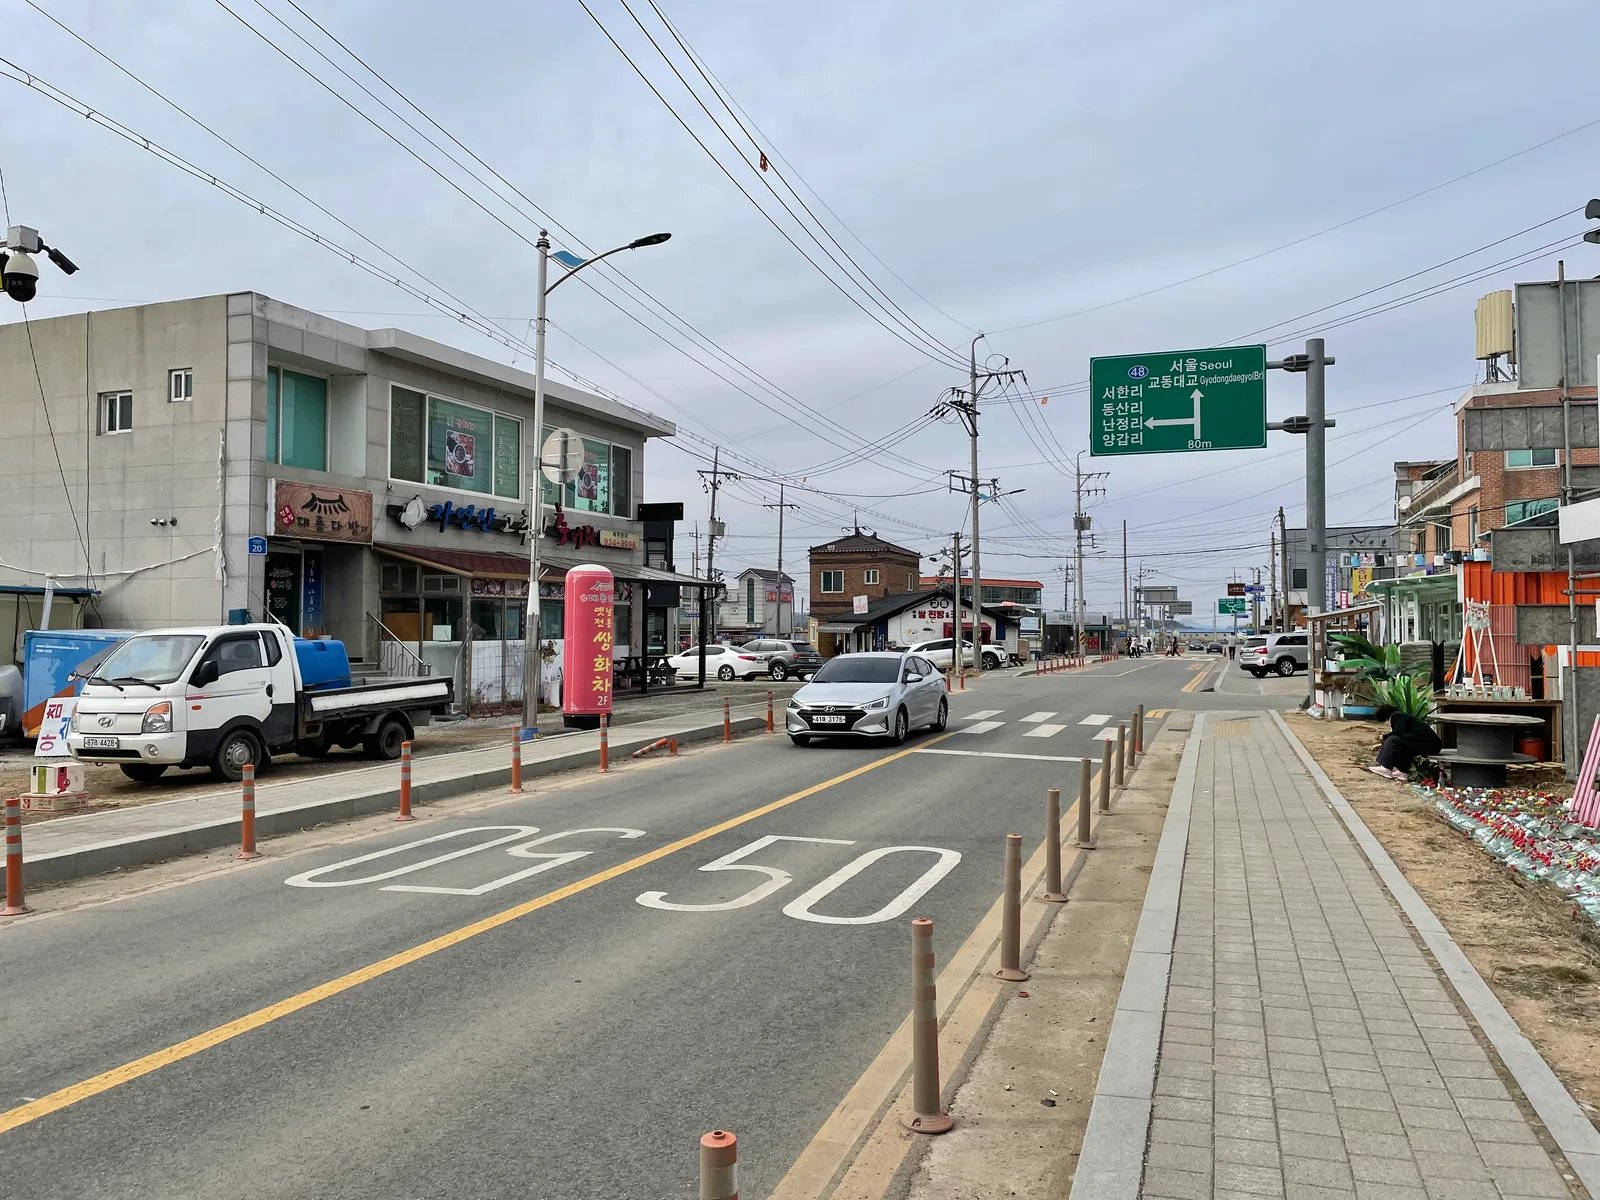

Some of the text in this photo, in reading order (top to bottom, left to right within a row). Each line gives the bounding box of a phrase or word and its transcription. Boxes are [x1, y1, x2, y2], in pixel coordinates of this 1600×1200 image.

[1130, 366, 1146, 377] 48
[1169, 358, 1233, 373] 서울 Seoul
[1148, 371, 1263, 389] 교동대교 Gyodongdaegyo(Br)
[1102, 384, 1144, 400] 서한리
[1102, 401, 1144, 416] 동산리
[1102, 417, 1144, 432] 난정리
[1102, 432, 1144, 447] 양갑리
[1187, 439, 1212, 449] 80m
[252, 544, 263, 553] 20
[592, 631, 613, 693] 쌍화차
[597, 695, 609, 706] 2F
[635, 835, 963, 925] 50
